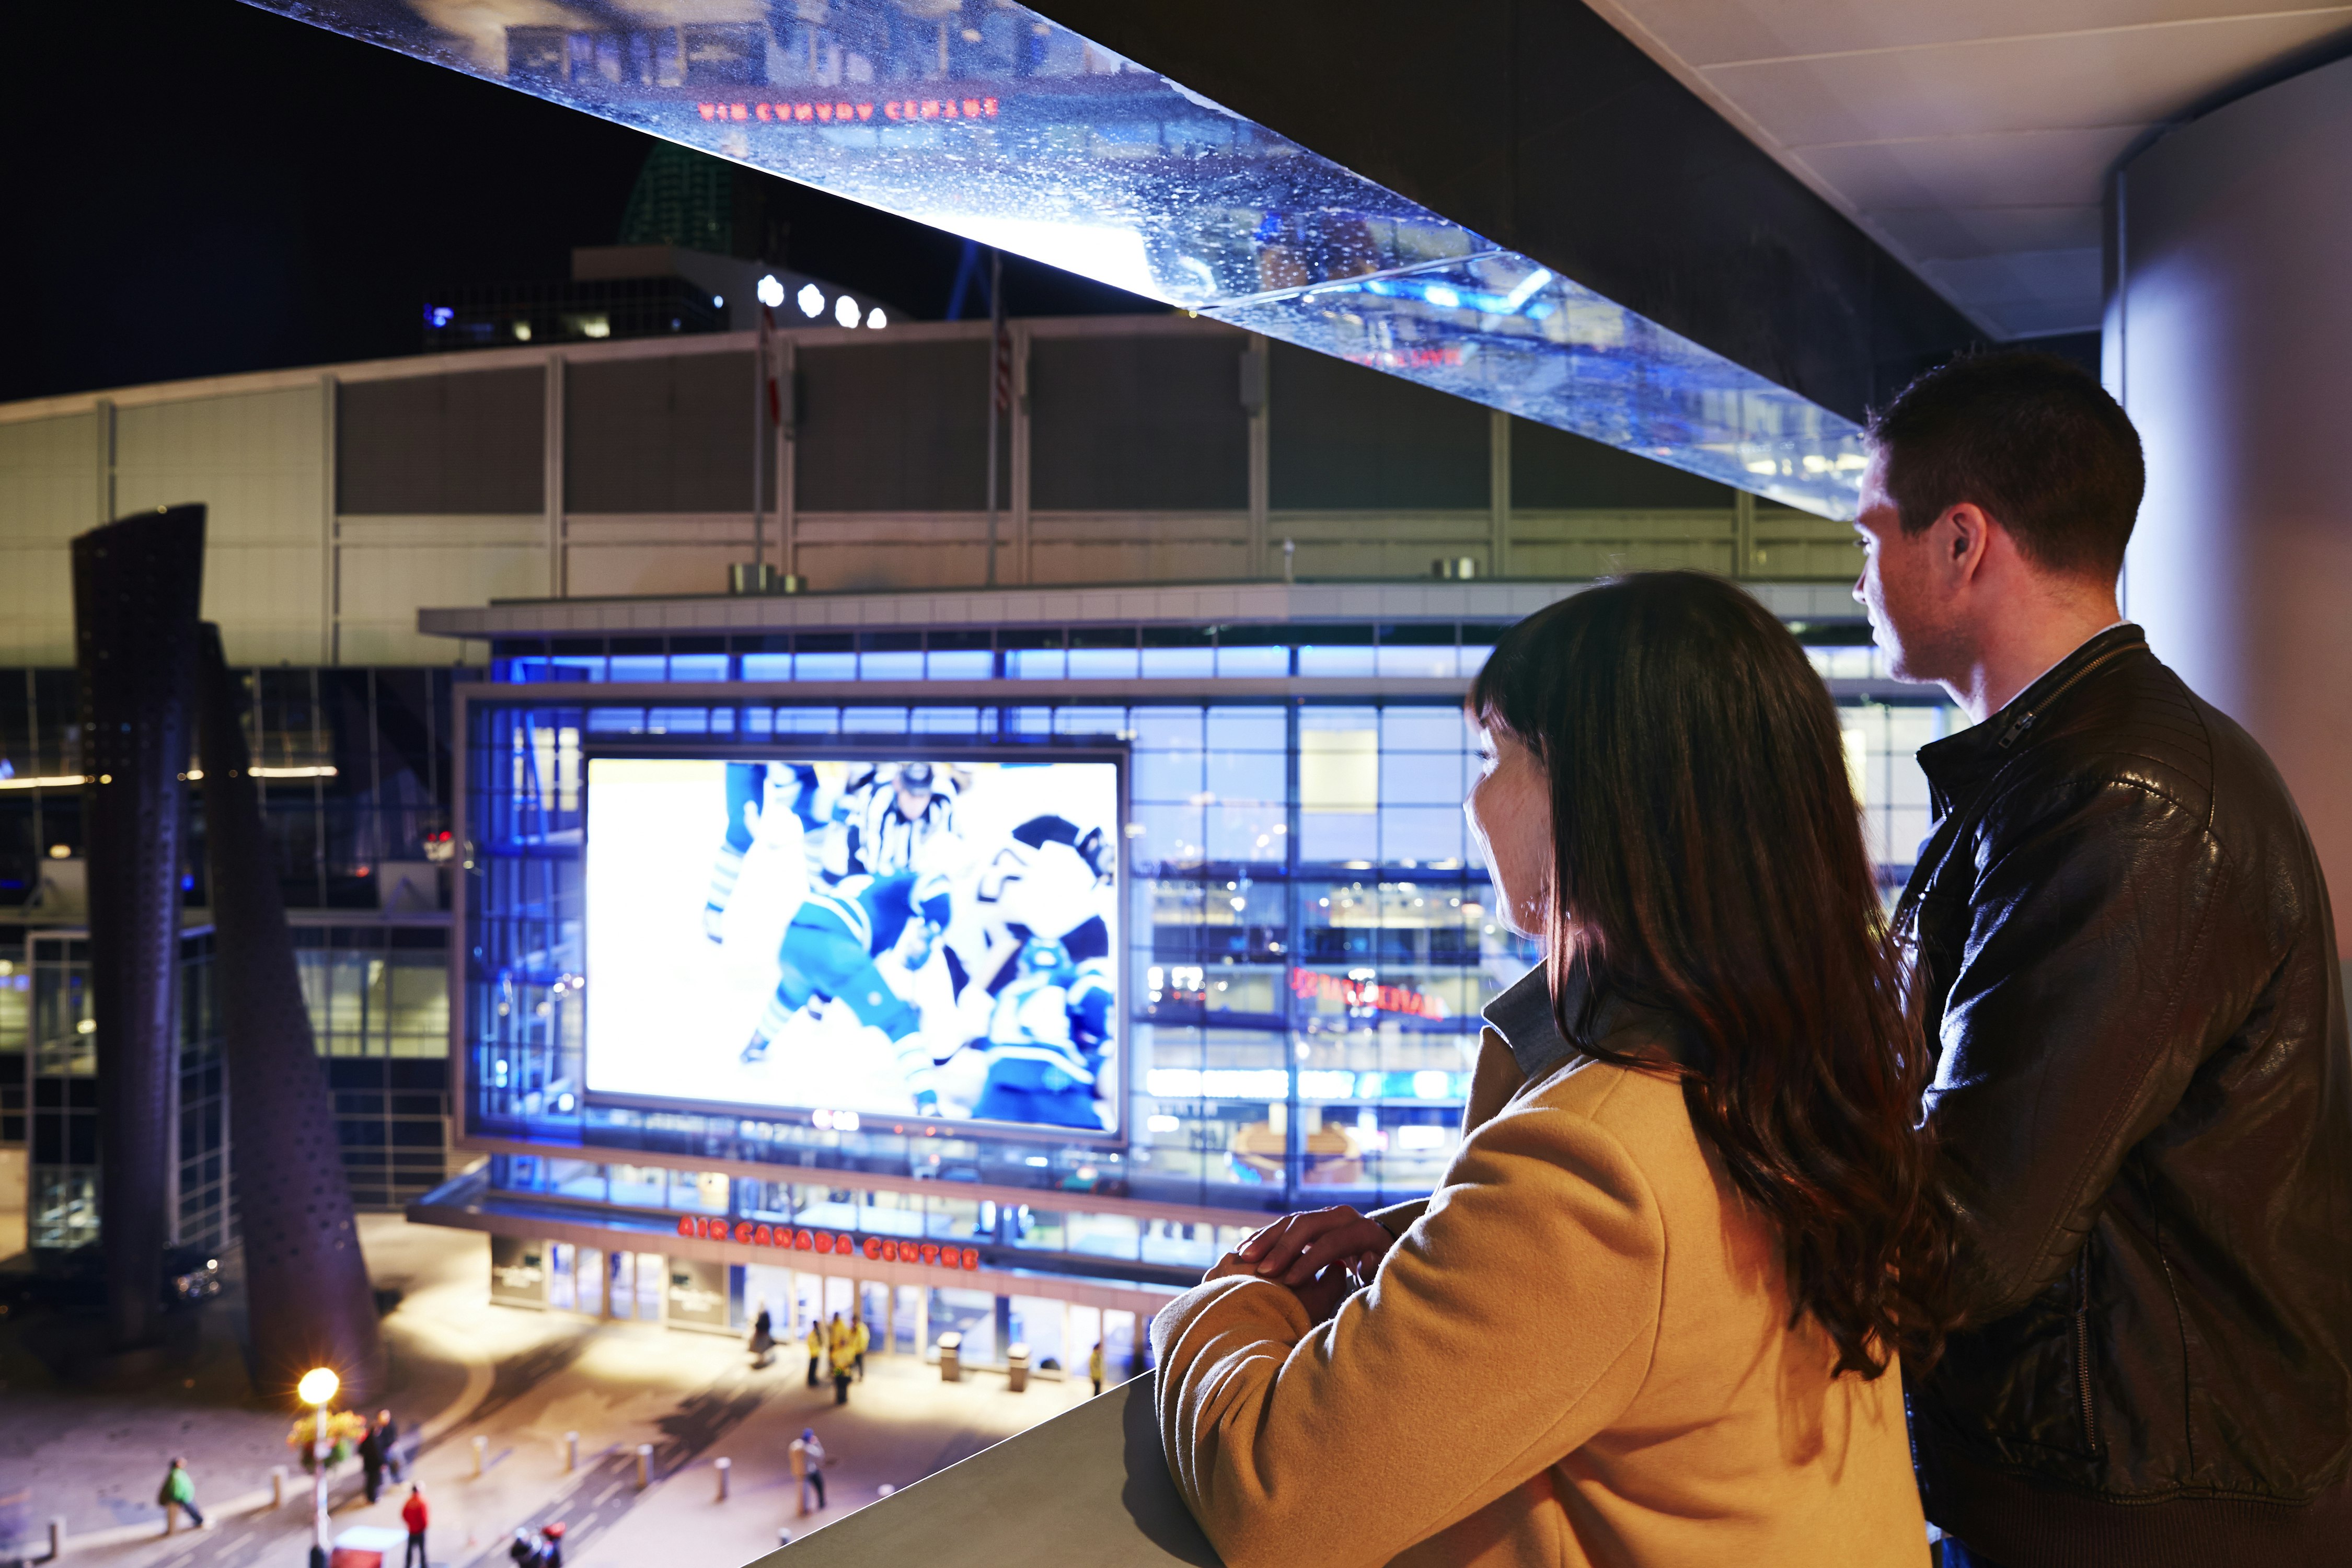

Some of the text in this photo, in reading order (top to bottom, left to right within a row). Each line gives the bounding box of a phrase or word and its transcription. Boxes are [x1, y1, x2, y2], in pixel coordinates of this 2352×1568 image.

[677, 1215, 980, 1271] AIR CANADA CENTRE
